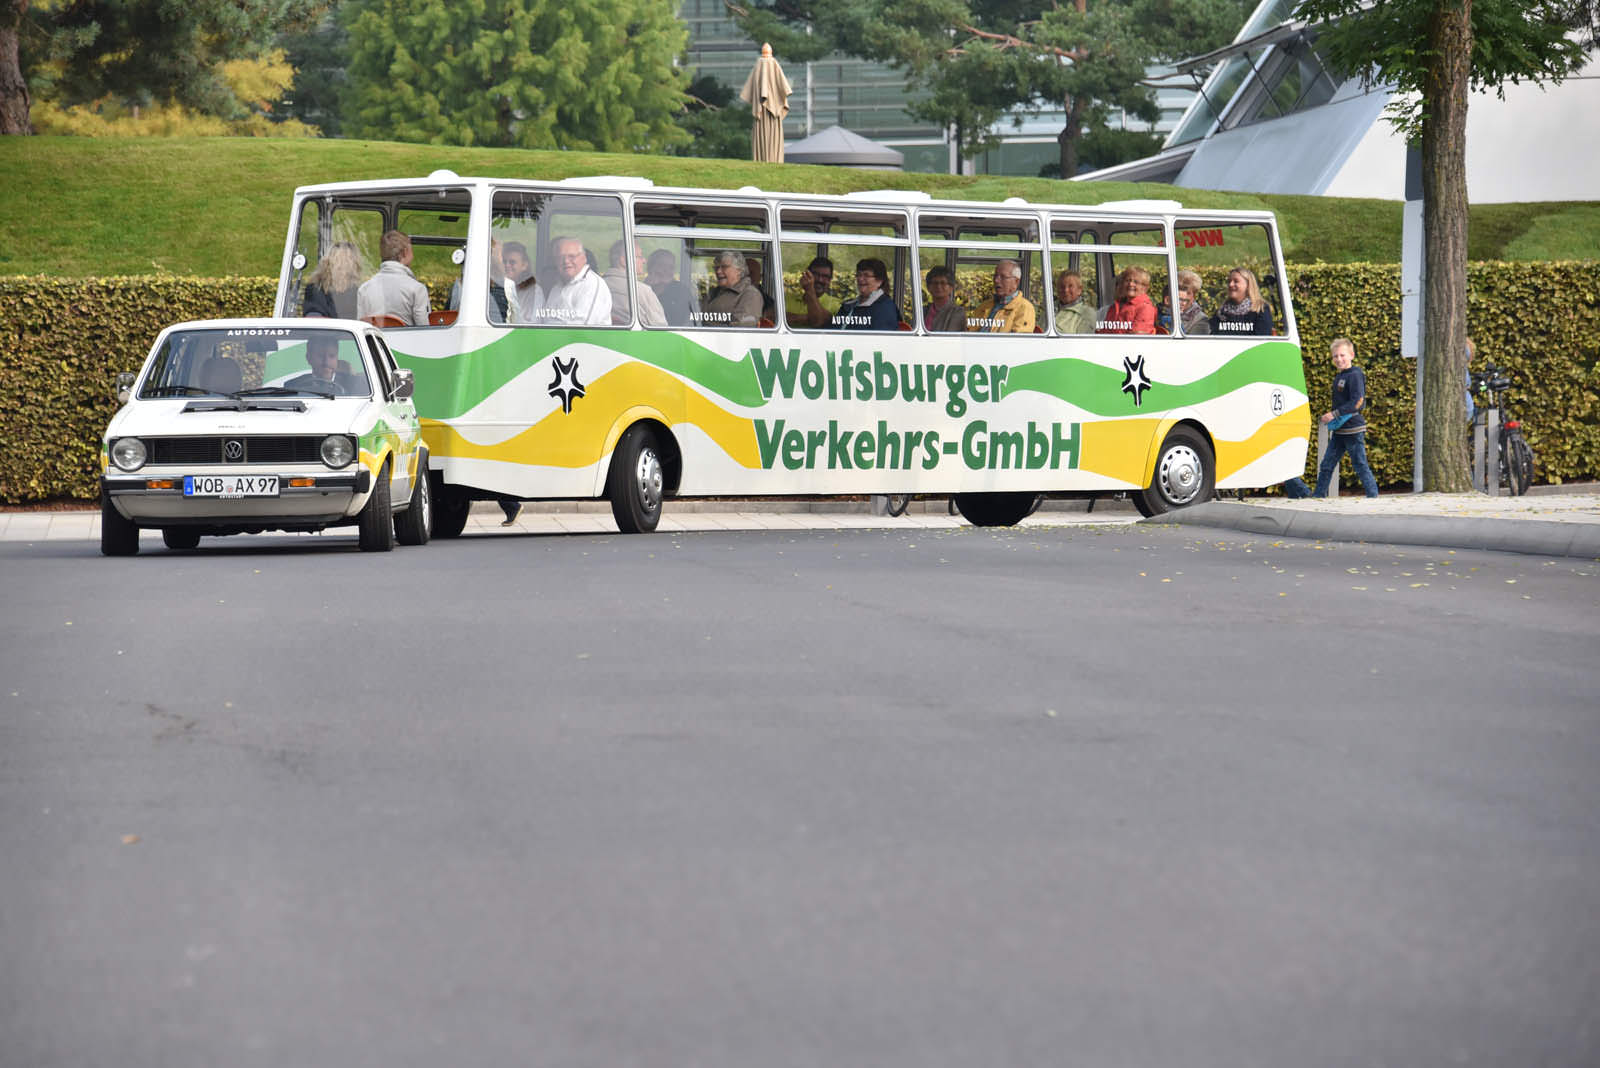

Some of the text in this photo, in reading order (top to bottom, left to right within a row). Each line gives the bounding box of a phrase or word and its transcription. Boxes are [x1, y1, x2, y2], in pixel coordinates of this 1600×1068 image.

[689, 311, 732, 322] AUTOSTADT
[831, 315, 872, 326] AUTOSTADT
[967, 317, 1006, 328] AUTOSTADT
[1095, 320, 1133, 330] AUTOSTADT
[1218, 321, 1255, 332] AUTOSTADT
[750, 348, 1009, 418] Wolfsburger
[1273, 393, 1283, 411] 25
[753, 418, 1081, 471] Verkehrs-GmbH
[194, 478, 278, 493] WOB AX 97
